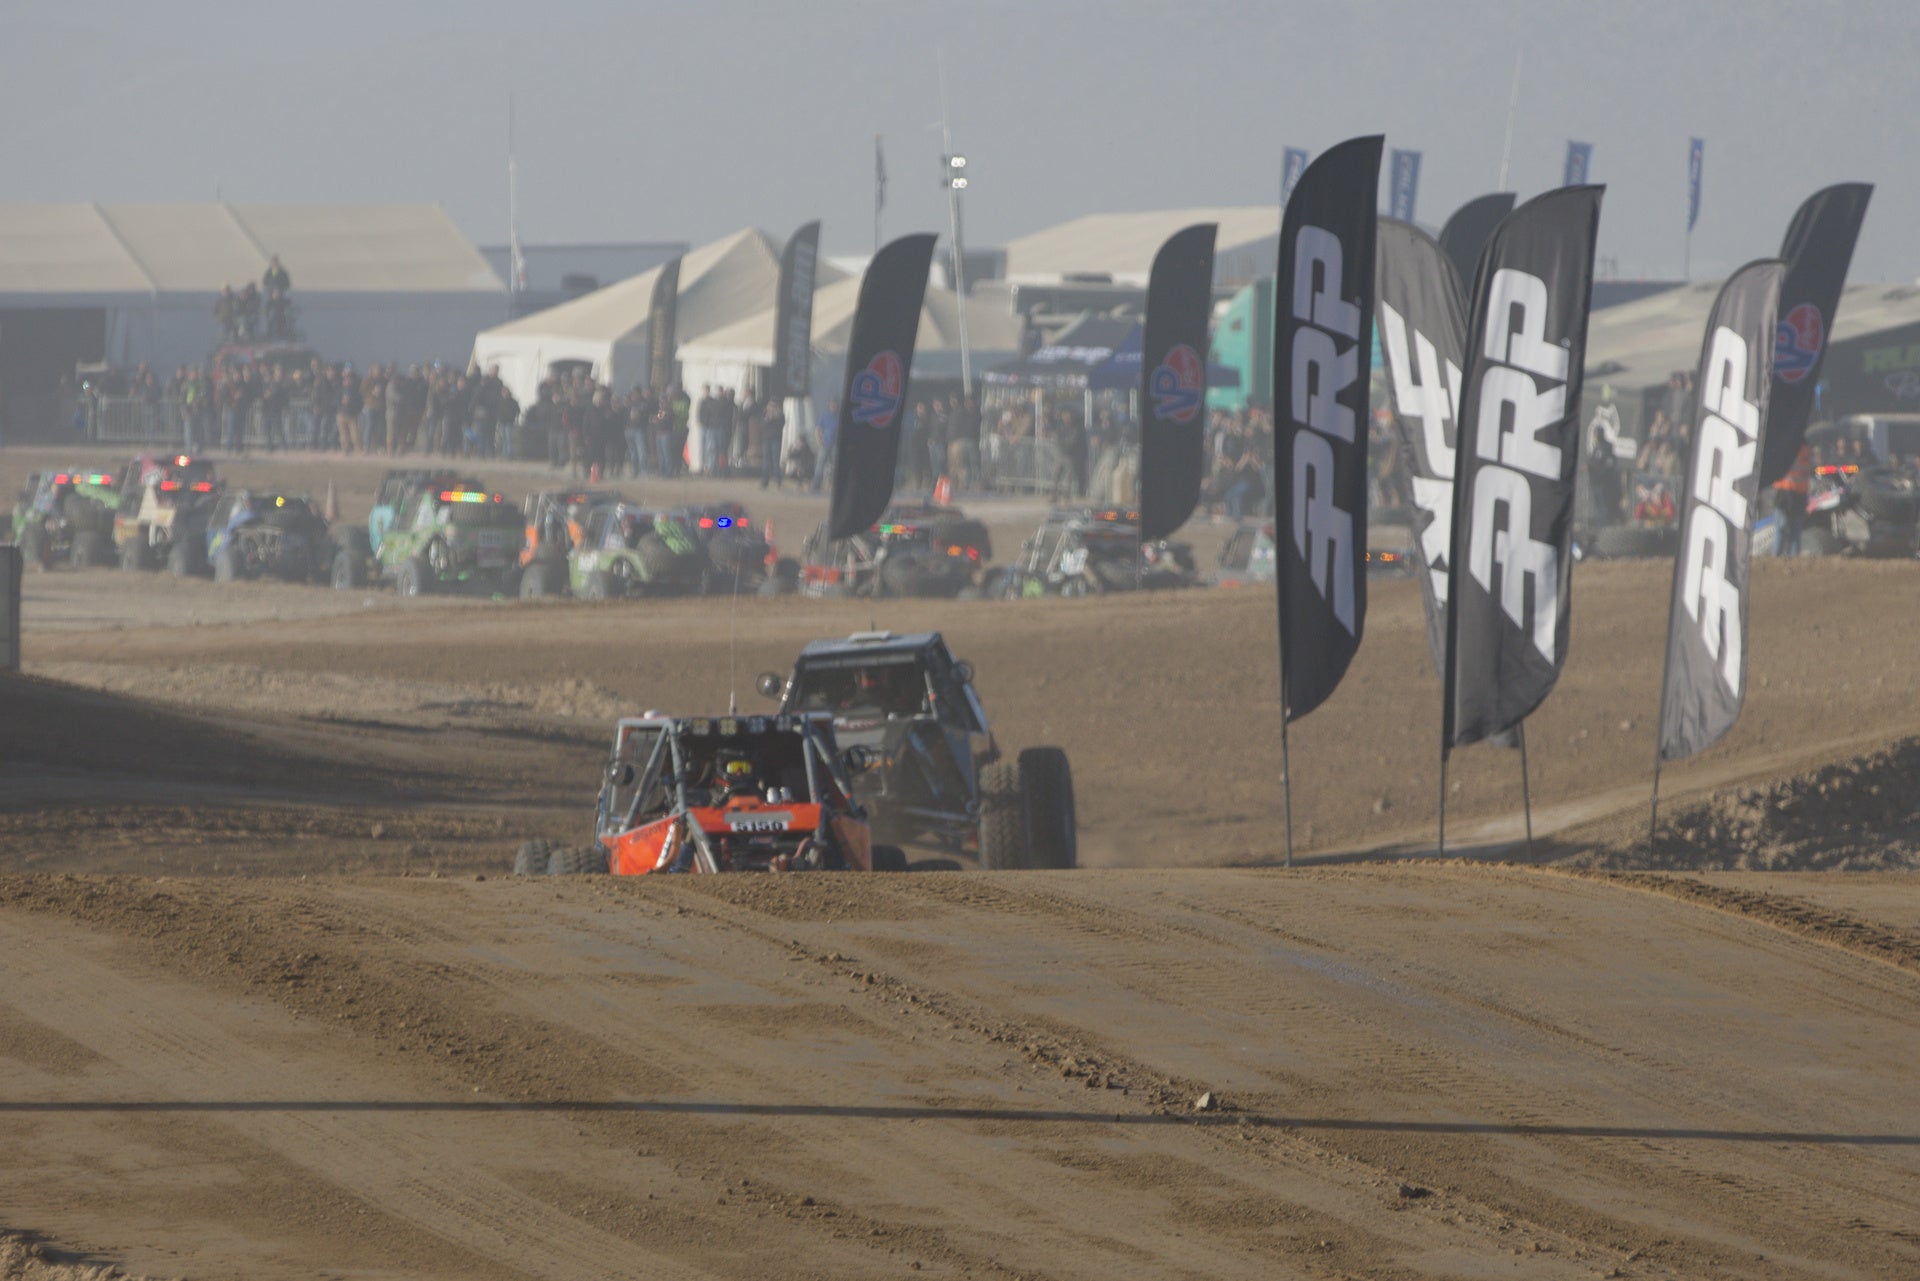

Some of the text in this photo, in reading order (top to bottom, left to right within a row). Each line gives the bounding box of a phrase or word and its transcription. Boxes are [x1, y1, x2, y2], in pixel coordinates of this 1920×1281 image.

[850, 368, 900, 424] VP
[1150, 364, 1201, 420] VP
[1290, 224, 1362, 638] PRP
[1468, 267, 1571, 667] PRP
[1683, 325, 1761, 701] PRP
